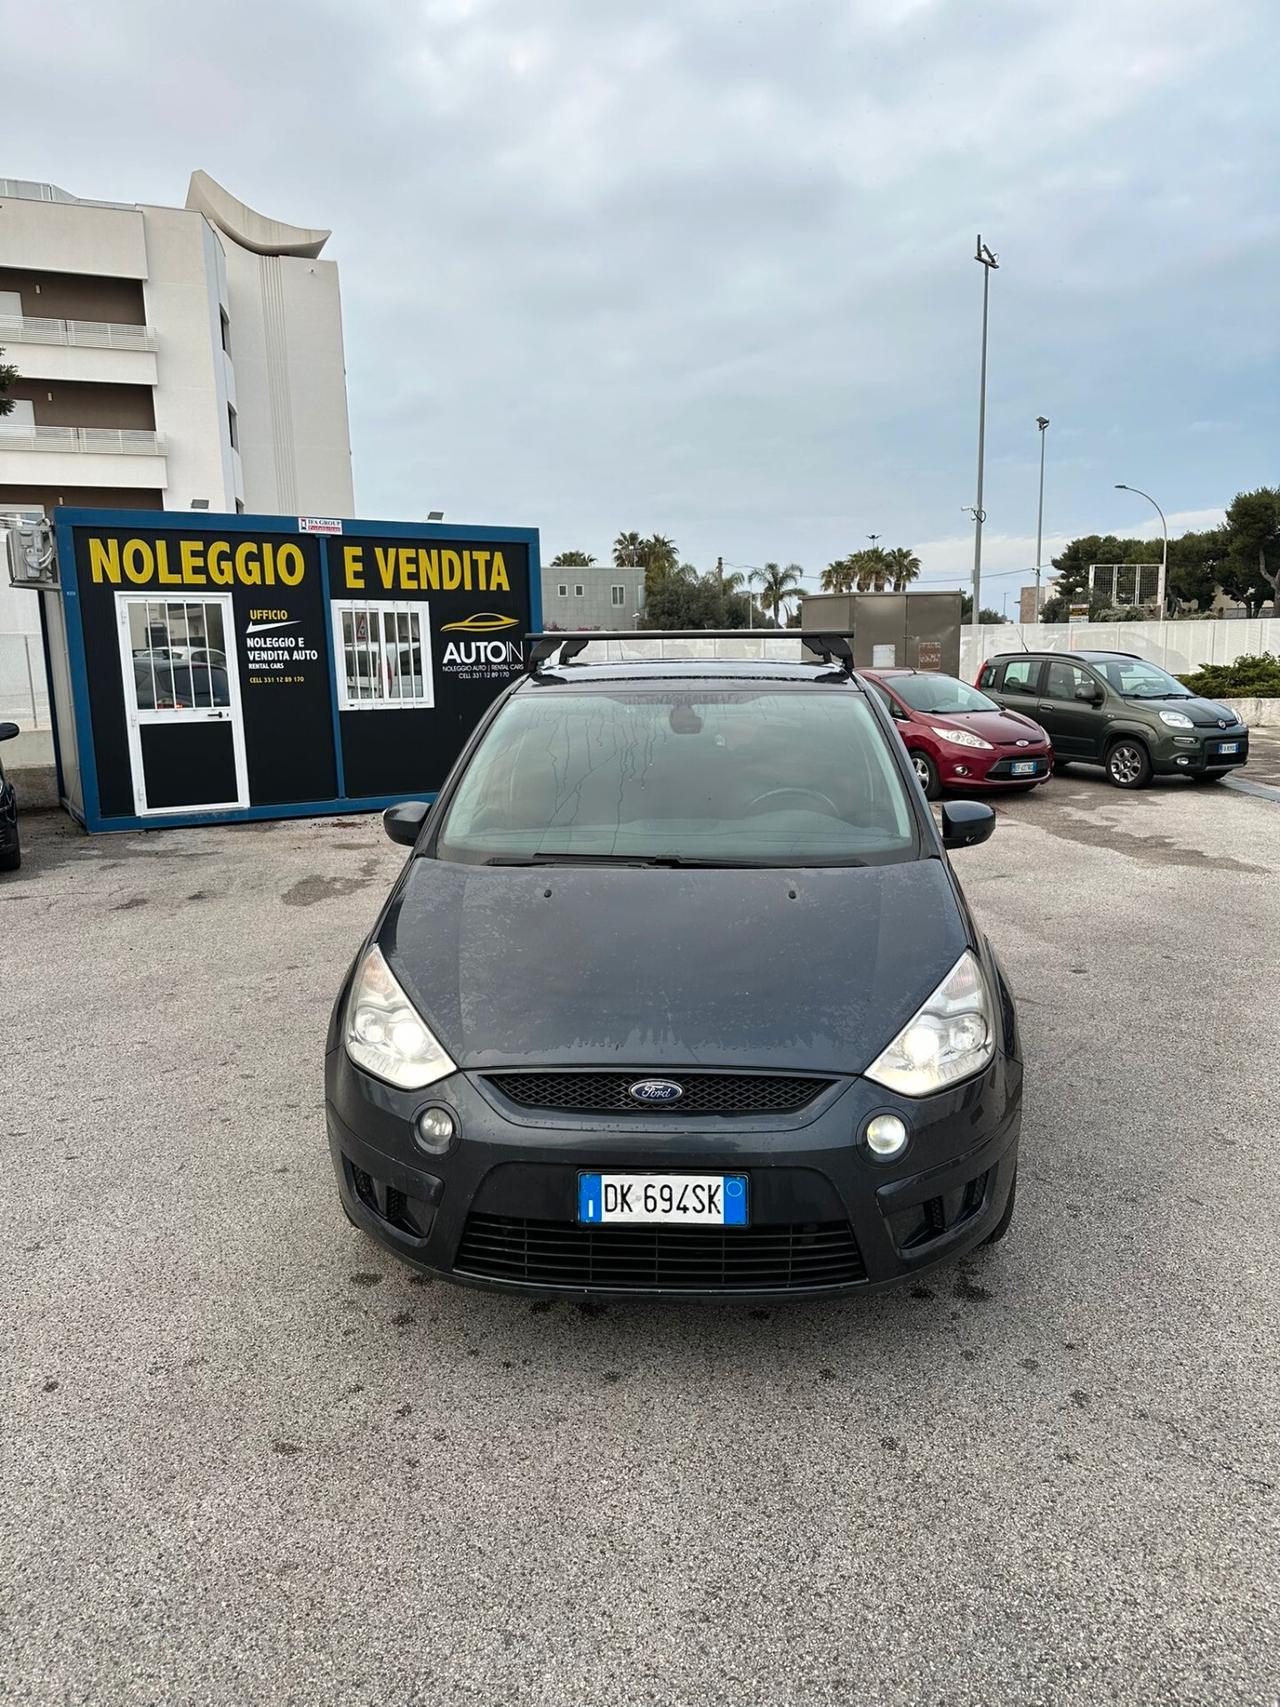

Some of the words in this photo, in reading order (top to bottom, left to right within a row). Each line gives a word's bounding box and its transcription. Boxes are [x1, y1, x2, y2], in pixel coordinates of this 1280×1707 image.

[88, 538, 305, 586] NOLEGGIO
[343, 546, 365, 589] E
[374, 547, 511, 591] VENDITA
[249, 609, 288, 620] UFFICIO
[246, 637, 296, 648] NOLEGGIO
[298, 637, 305, 648] E
[247, 650, 290, 661] VENDITA
[292, 650, 318, 660] AUTO
[641, 1085, 672, 1098] Ford
[604, 1183, 633, 1213] DK
[643, 1183, 722, 1214] 694SK
